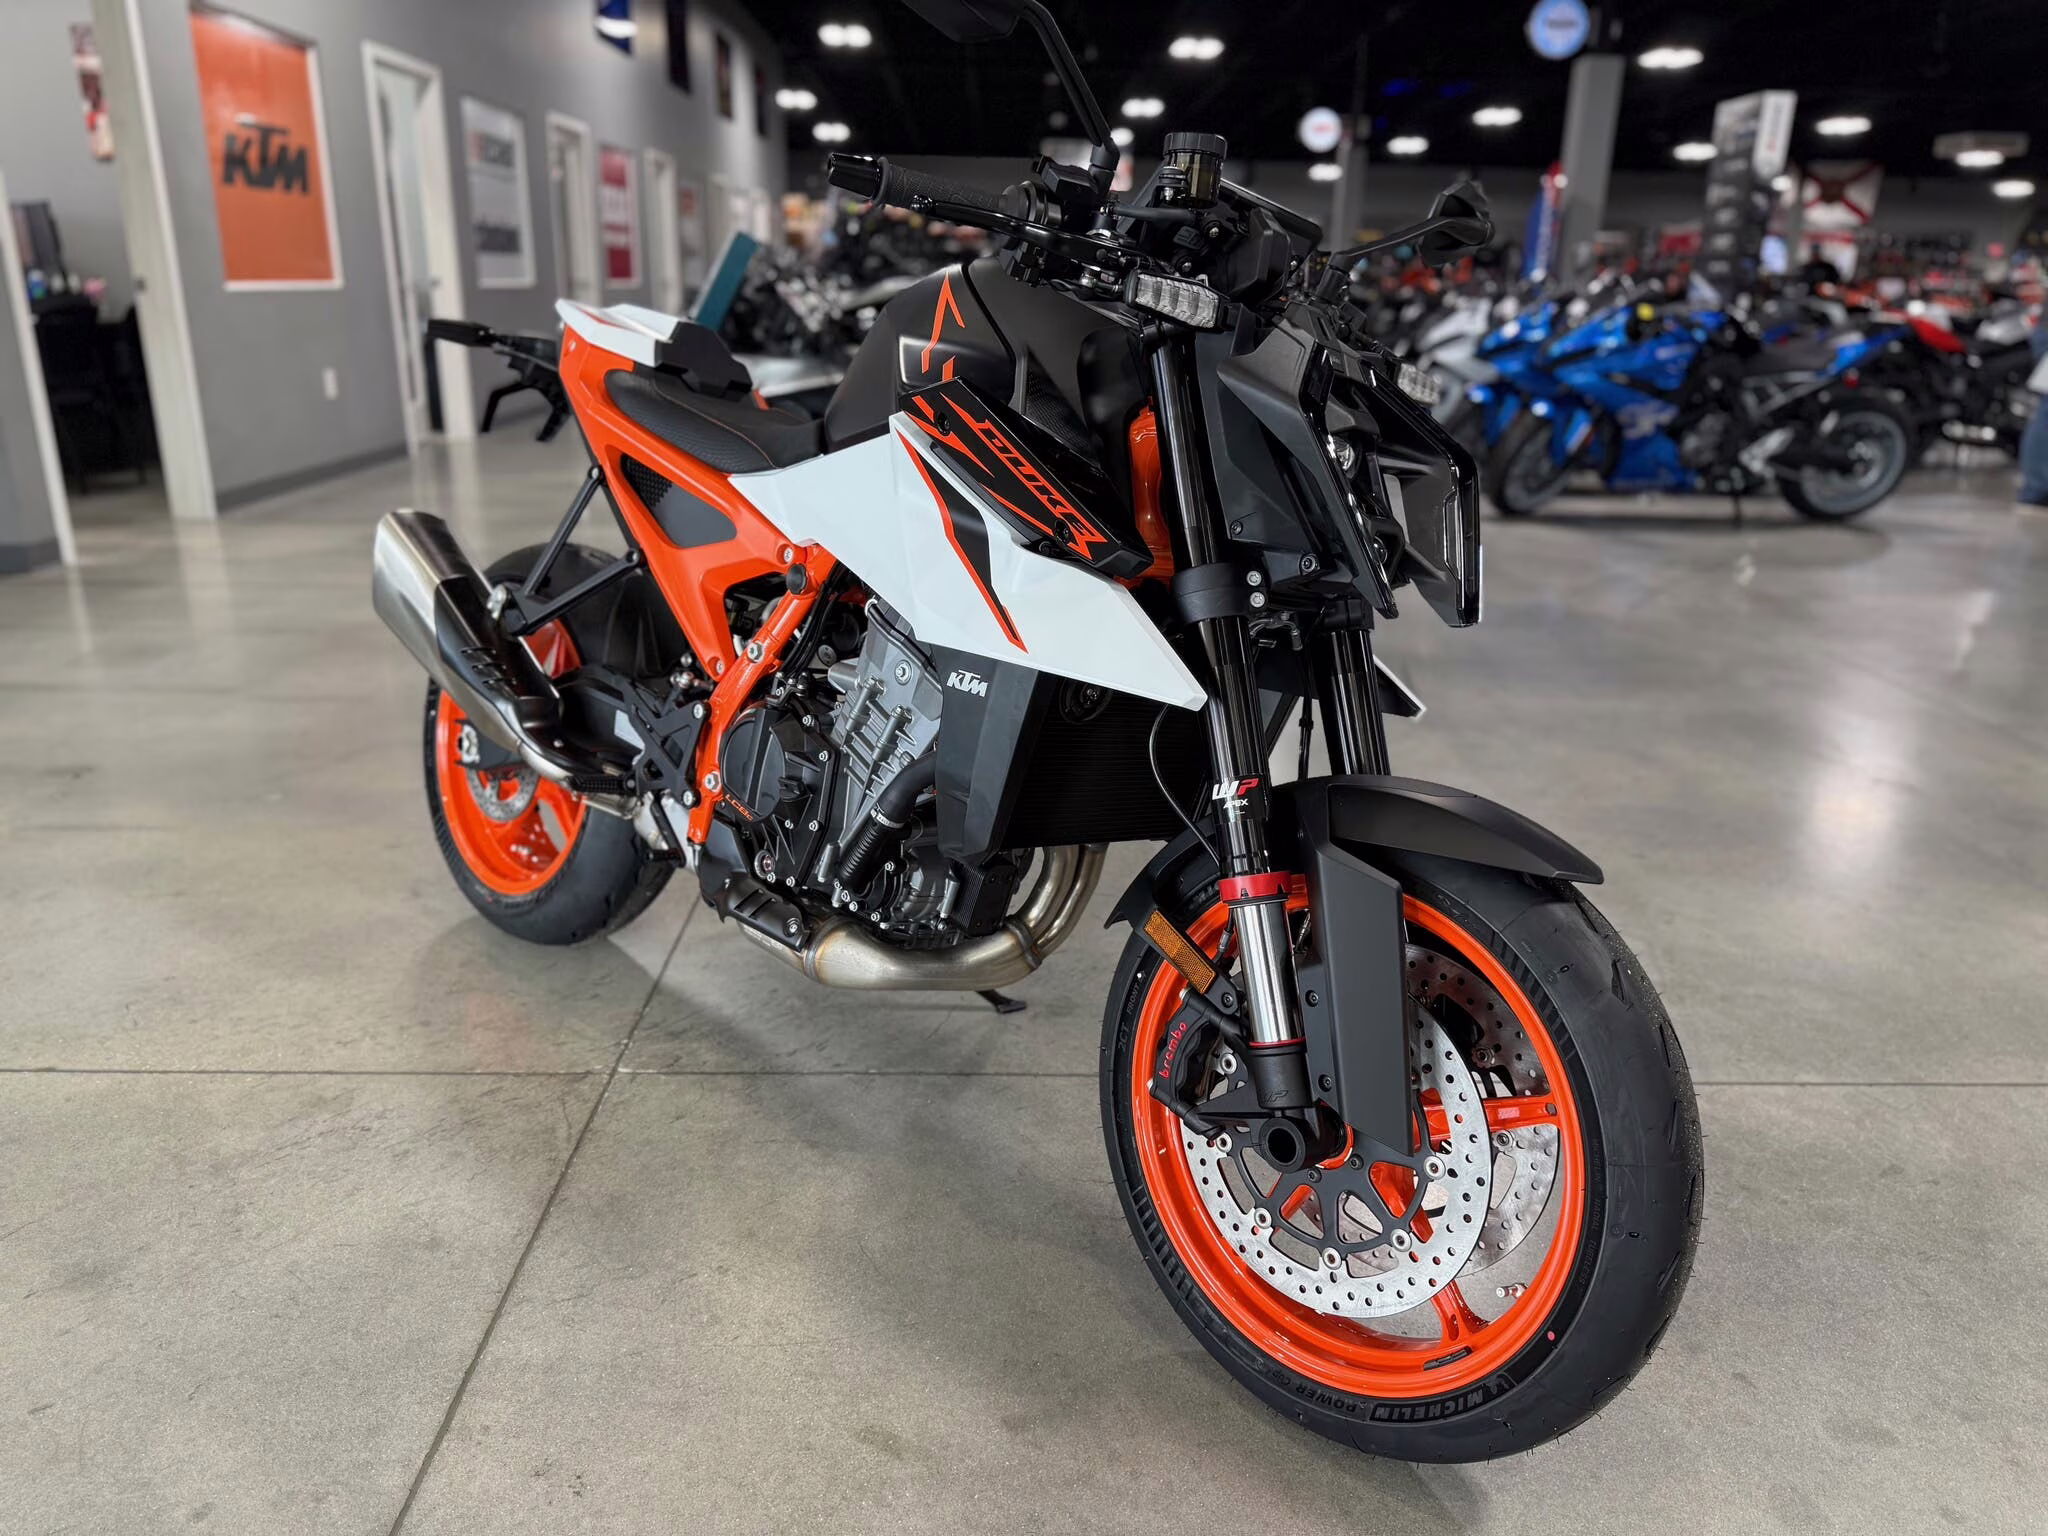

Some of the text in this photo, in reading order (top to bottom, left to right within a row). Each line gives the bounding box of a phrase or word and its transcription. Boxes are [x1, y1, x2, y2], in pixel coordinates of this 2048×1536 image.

[223, 122, 310, 195] KTM
[978, 427, 1097, 537] DUKE
[947, 670, 988, 697] KTM
[1212, 778, 1259, 800] WP
[1159, 1022, 1188, 1078] brembo
[1296, 1385, 1358, 1413] POWER
[1375, 1389, 1483, 1419] MICHELIN
